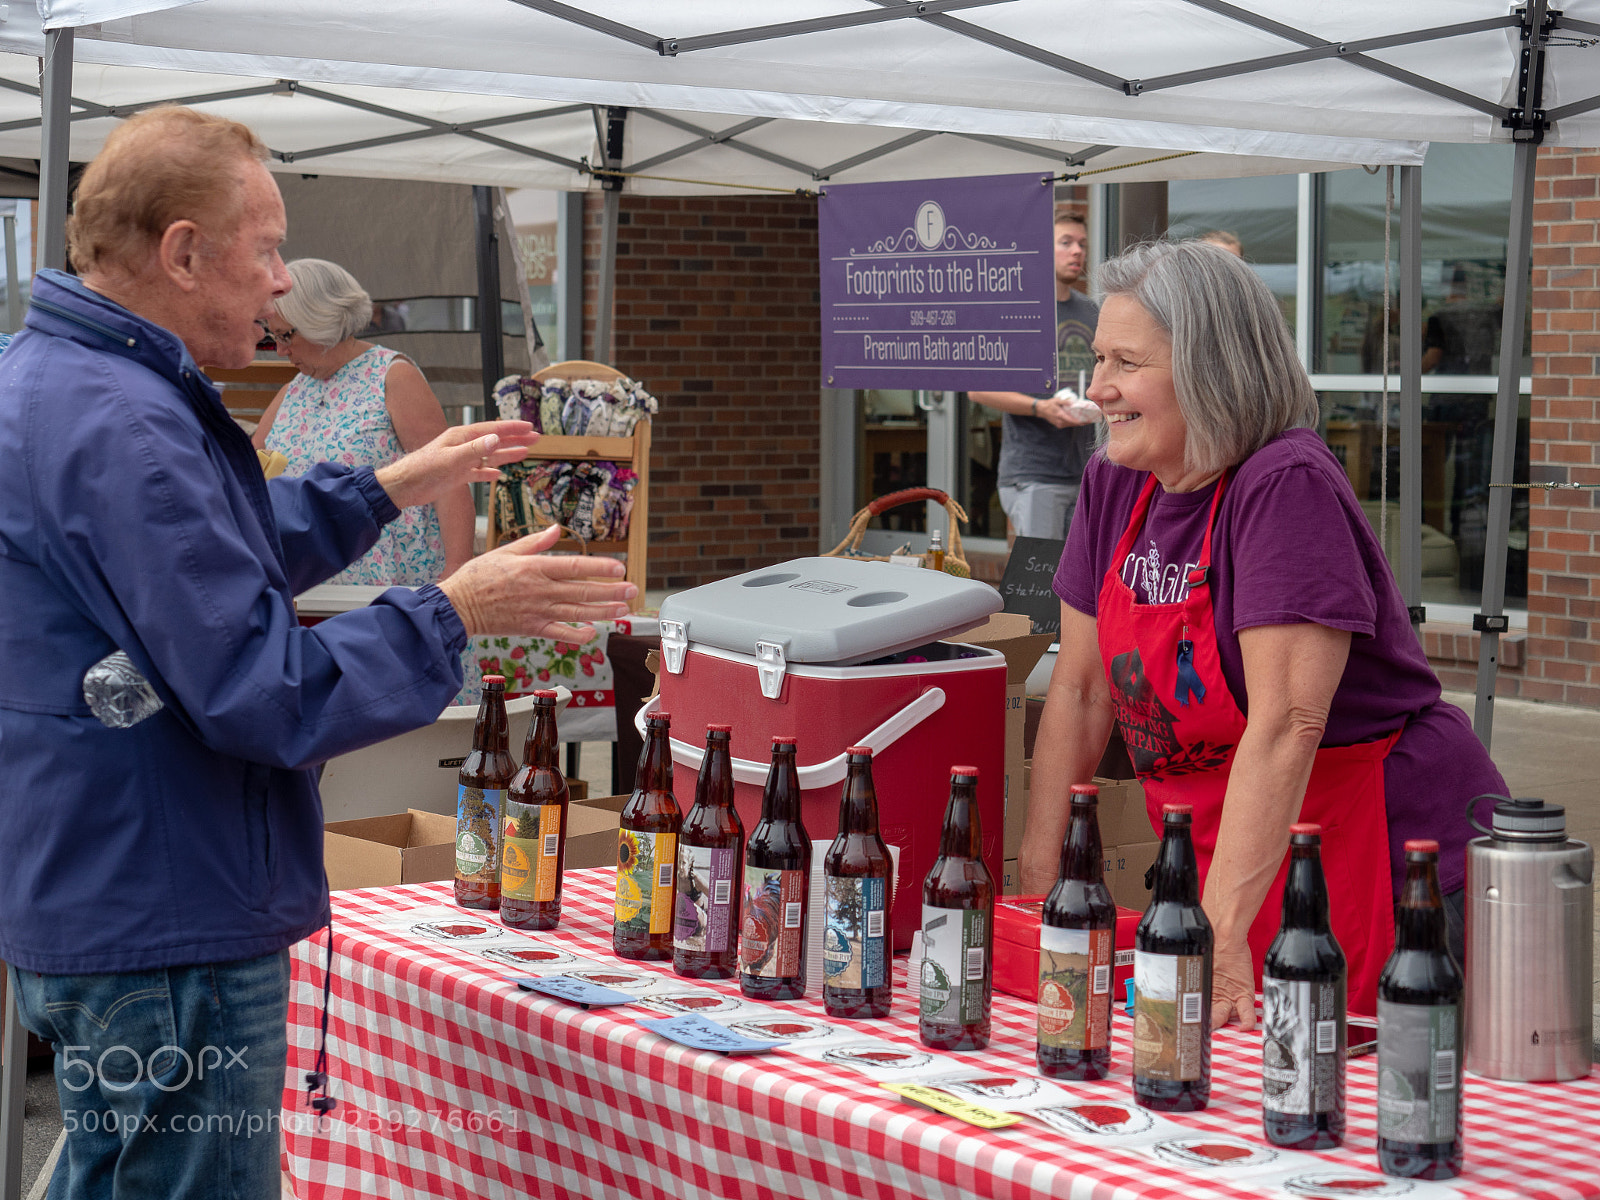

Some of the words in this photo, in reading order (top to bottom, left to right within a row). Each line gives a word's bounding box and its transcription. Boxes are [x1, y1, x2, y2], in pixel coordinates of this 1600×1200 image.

[927, 210, 934, 241] F
[516, 235, 557, 257] NDAL
[846, 262, 925, 299] Footprints
[928, 263, 944, 293] to
[946, 260, 973, 293] the
[977, 257, 1023, 292] Heart
[910, 310, 957, 326] 509-467-2361
[864, 334, 921, 361] Premium
[923, 334, 950, 361] Bath
[952, 336, 975, 361] and
[978, 334, 1009, 365] Body
[1025, 556, 1055, 573] Scru
[1006, 583, 1052, 598] Station
[1012, 696, 1022, 710] OZ.
[1119, 725, 1173, 755] OMPANY
[1117, 858, 1126, 870] 12
